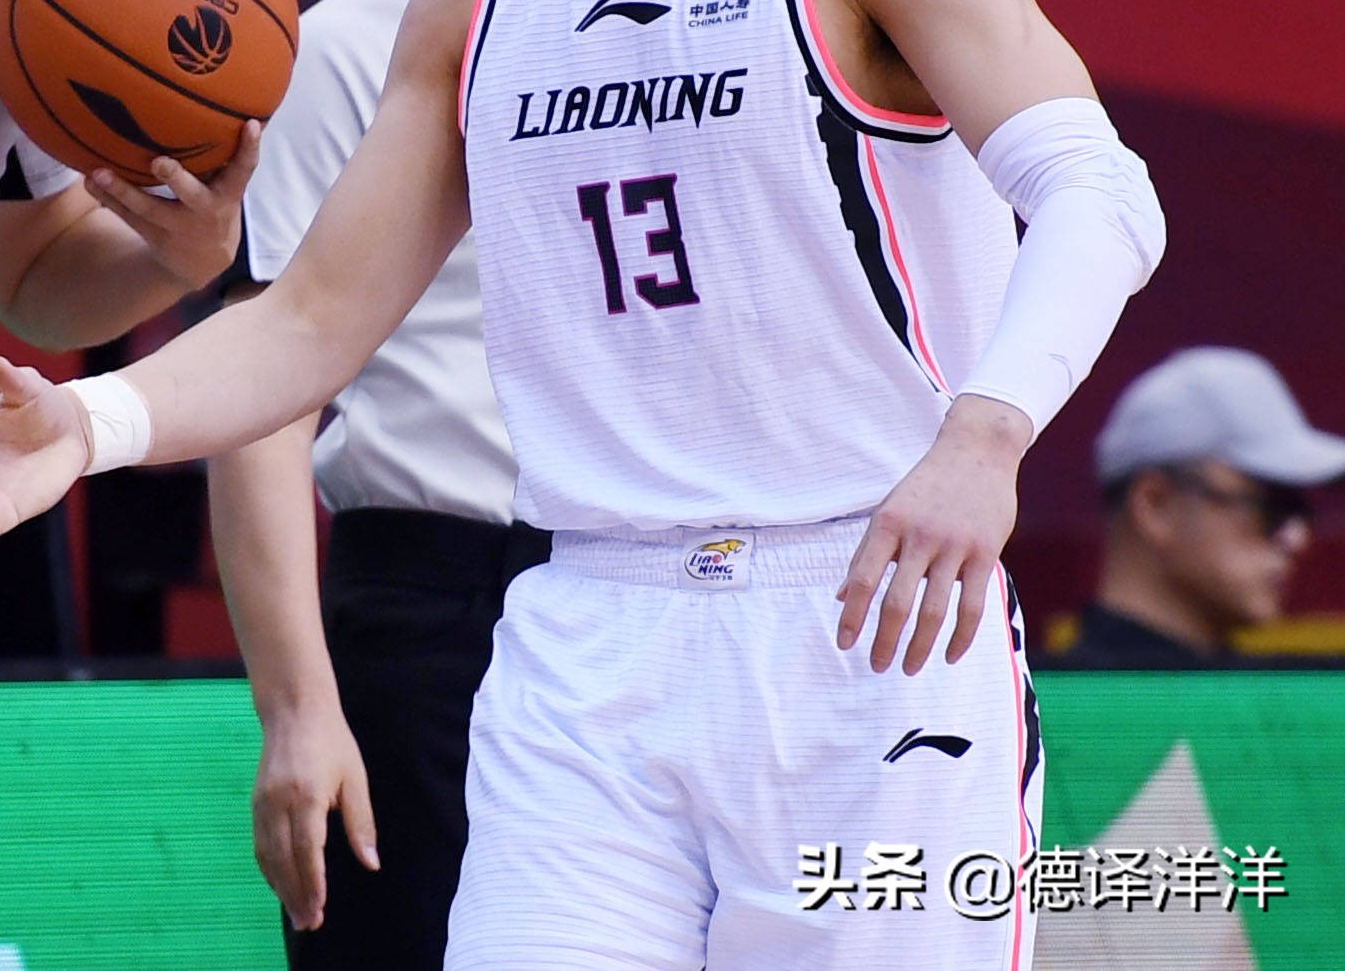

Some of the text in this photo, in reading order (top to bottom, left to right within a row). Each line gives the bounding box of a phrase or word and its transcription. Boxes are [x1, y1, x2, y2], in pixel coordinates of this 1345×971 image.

[688, 11, 749, 28] CHINA LIFE
[509, 67, 748, 142] LIAONING
[576, 173, 700, 315] 13
